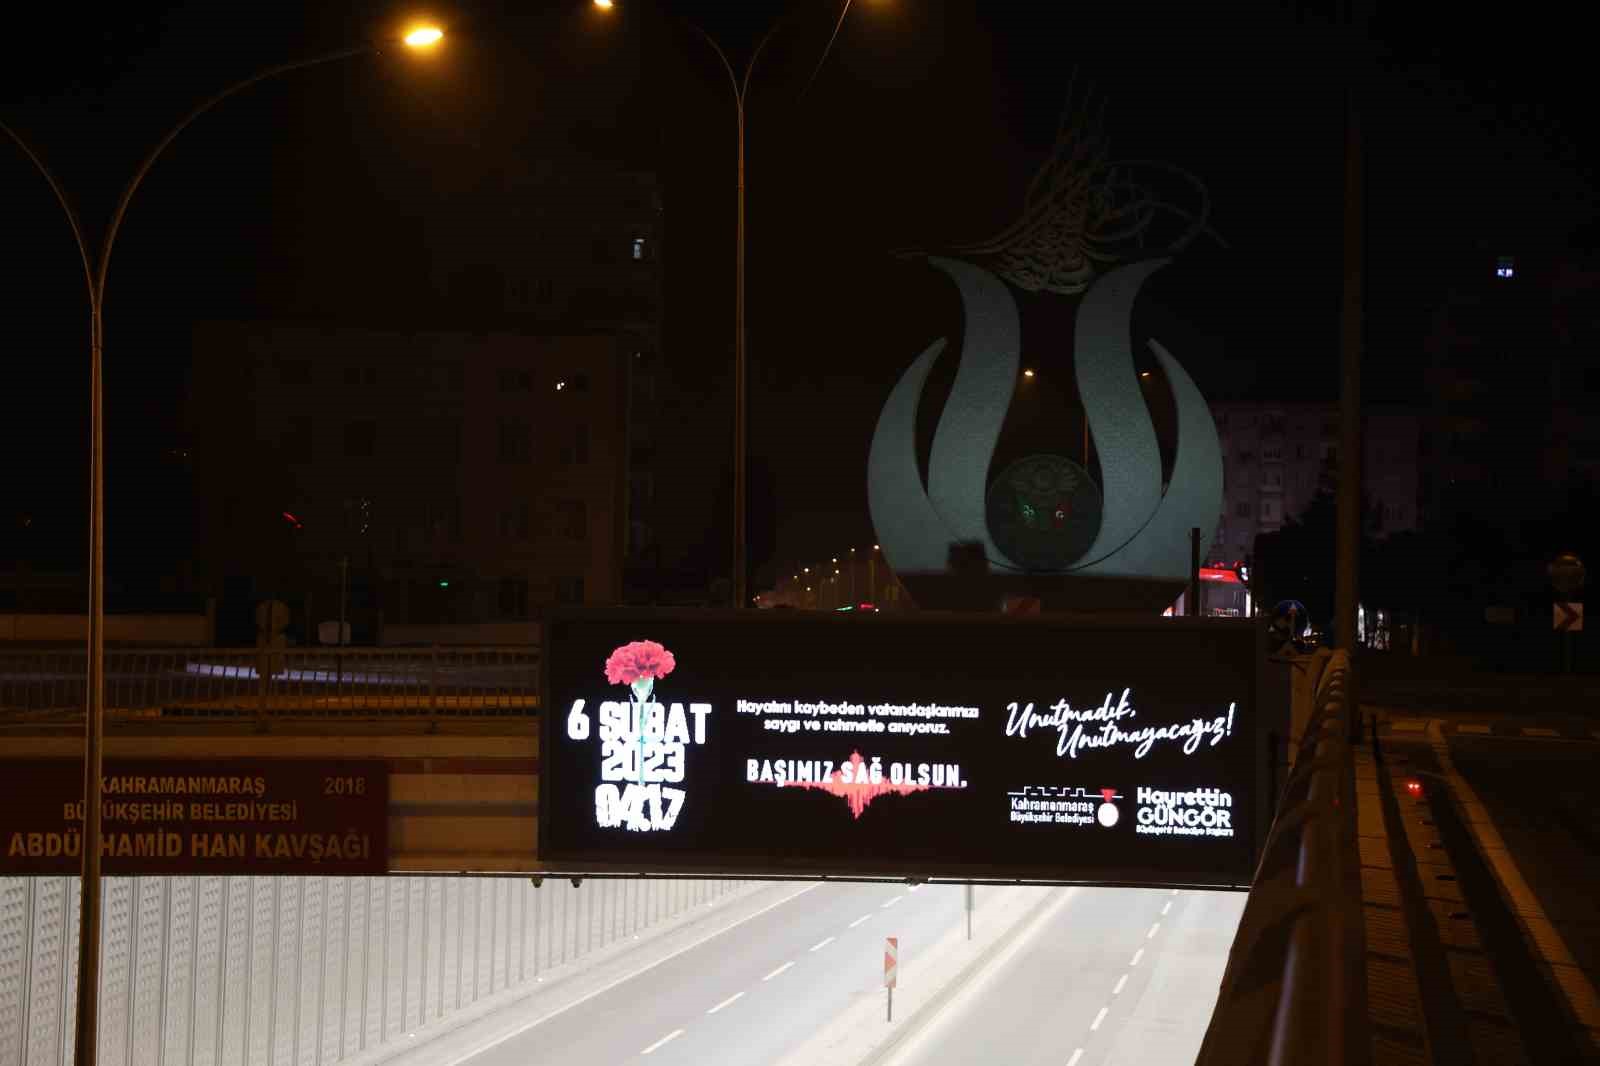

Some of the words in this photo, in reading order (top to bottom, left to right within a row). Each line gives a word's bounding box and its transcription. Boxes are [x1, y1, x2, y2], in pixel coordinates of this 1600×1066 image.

[567, 698, 590, 740] 6
[737, 699, 792, 716] Hayatını
[794, 700, 865, 717] kaybeden
[763, 719, 801, 733] saygı
[803, 720, 821, 731] ve
[824, 719, 885, 732] rahmetle
[887, 721, 950, 736] anıyoruz.
[602, 741, 685, 783] 2023
[747, 759, 833, 787] BAŞIMIZ
[840, 756, 883, 784] SAĞ
[890, 762, 968, 788] OLSUN.
[98, 776, 265, 798] KAHRAMANMARAŞ
[324, 776, 366, 795] 2018
[1011, 797, 1096, 813] Kahramanmaraş
[1136, 786, 1232, 809] Hayrettin
[63, 799, 185, 824] BÜÜKŞEHİR
[191, 798, 297, 822] BELEDİYESİ
[1136, 804, 1232, 828] GÜNGÖR
[8, 826, 184, 857] ABDÜHAMİD
[191, 832, 246, 857] HAN
[255, 827, 369, 864] KAVŞAĞI
